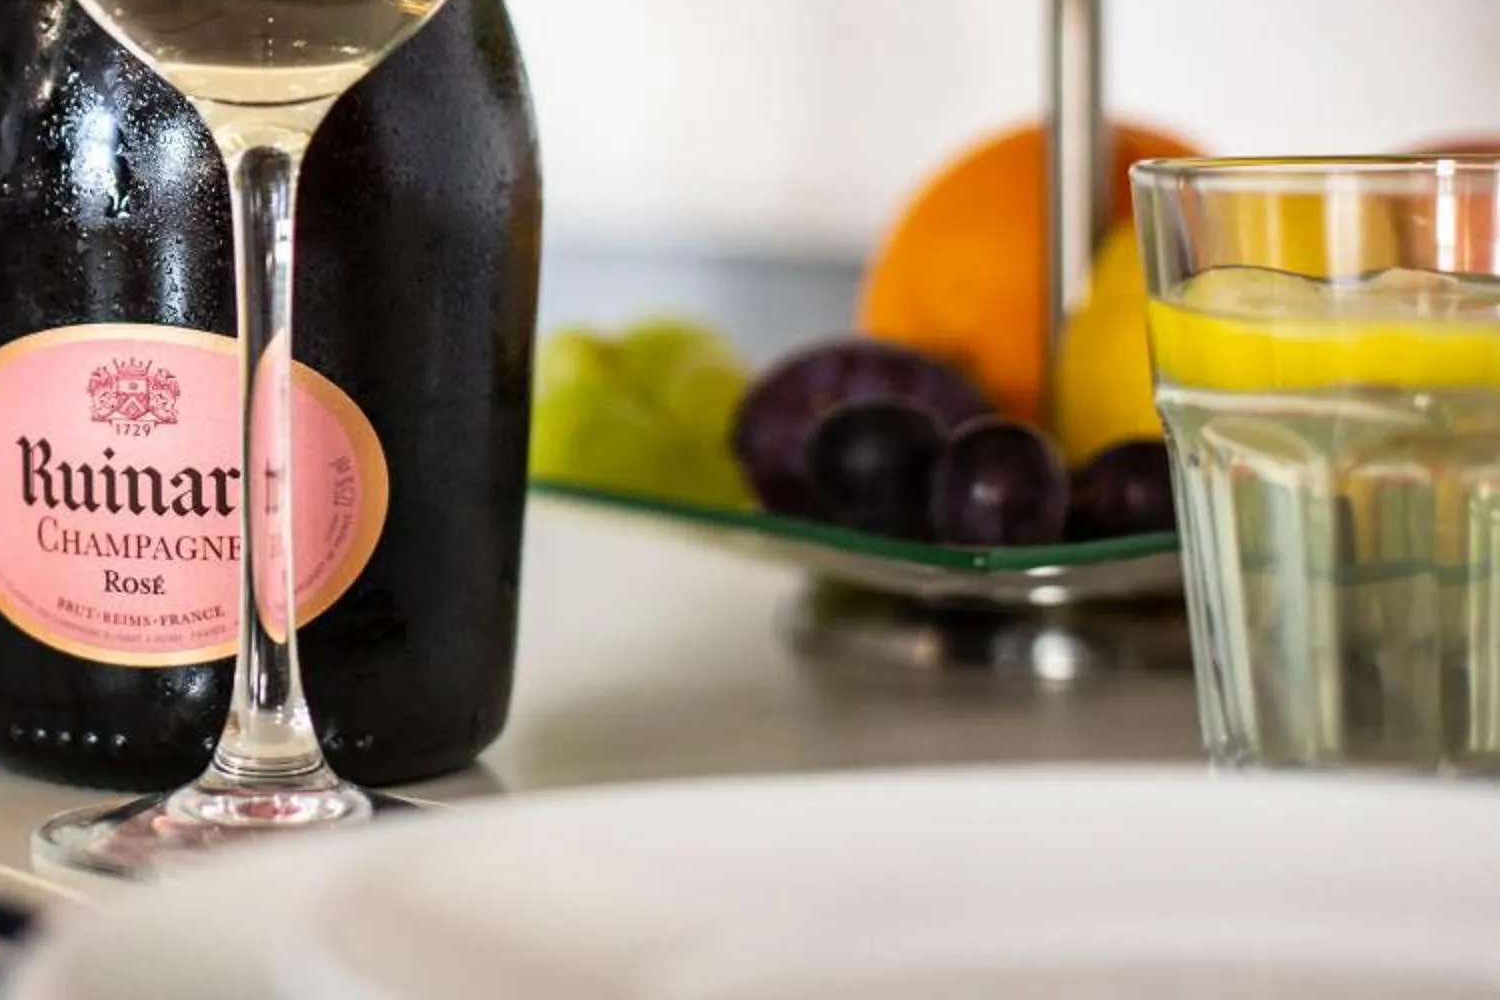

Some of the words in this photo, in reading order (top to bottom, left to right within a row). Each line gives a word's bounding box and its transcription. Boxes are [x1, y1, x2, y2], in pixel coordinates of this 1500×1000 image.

[115, 423, 152, 437] 1729
[37, 515, 242, 562] CHAMPAGNE
[103, 568, 166, 596] ROSÉ
